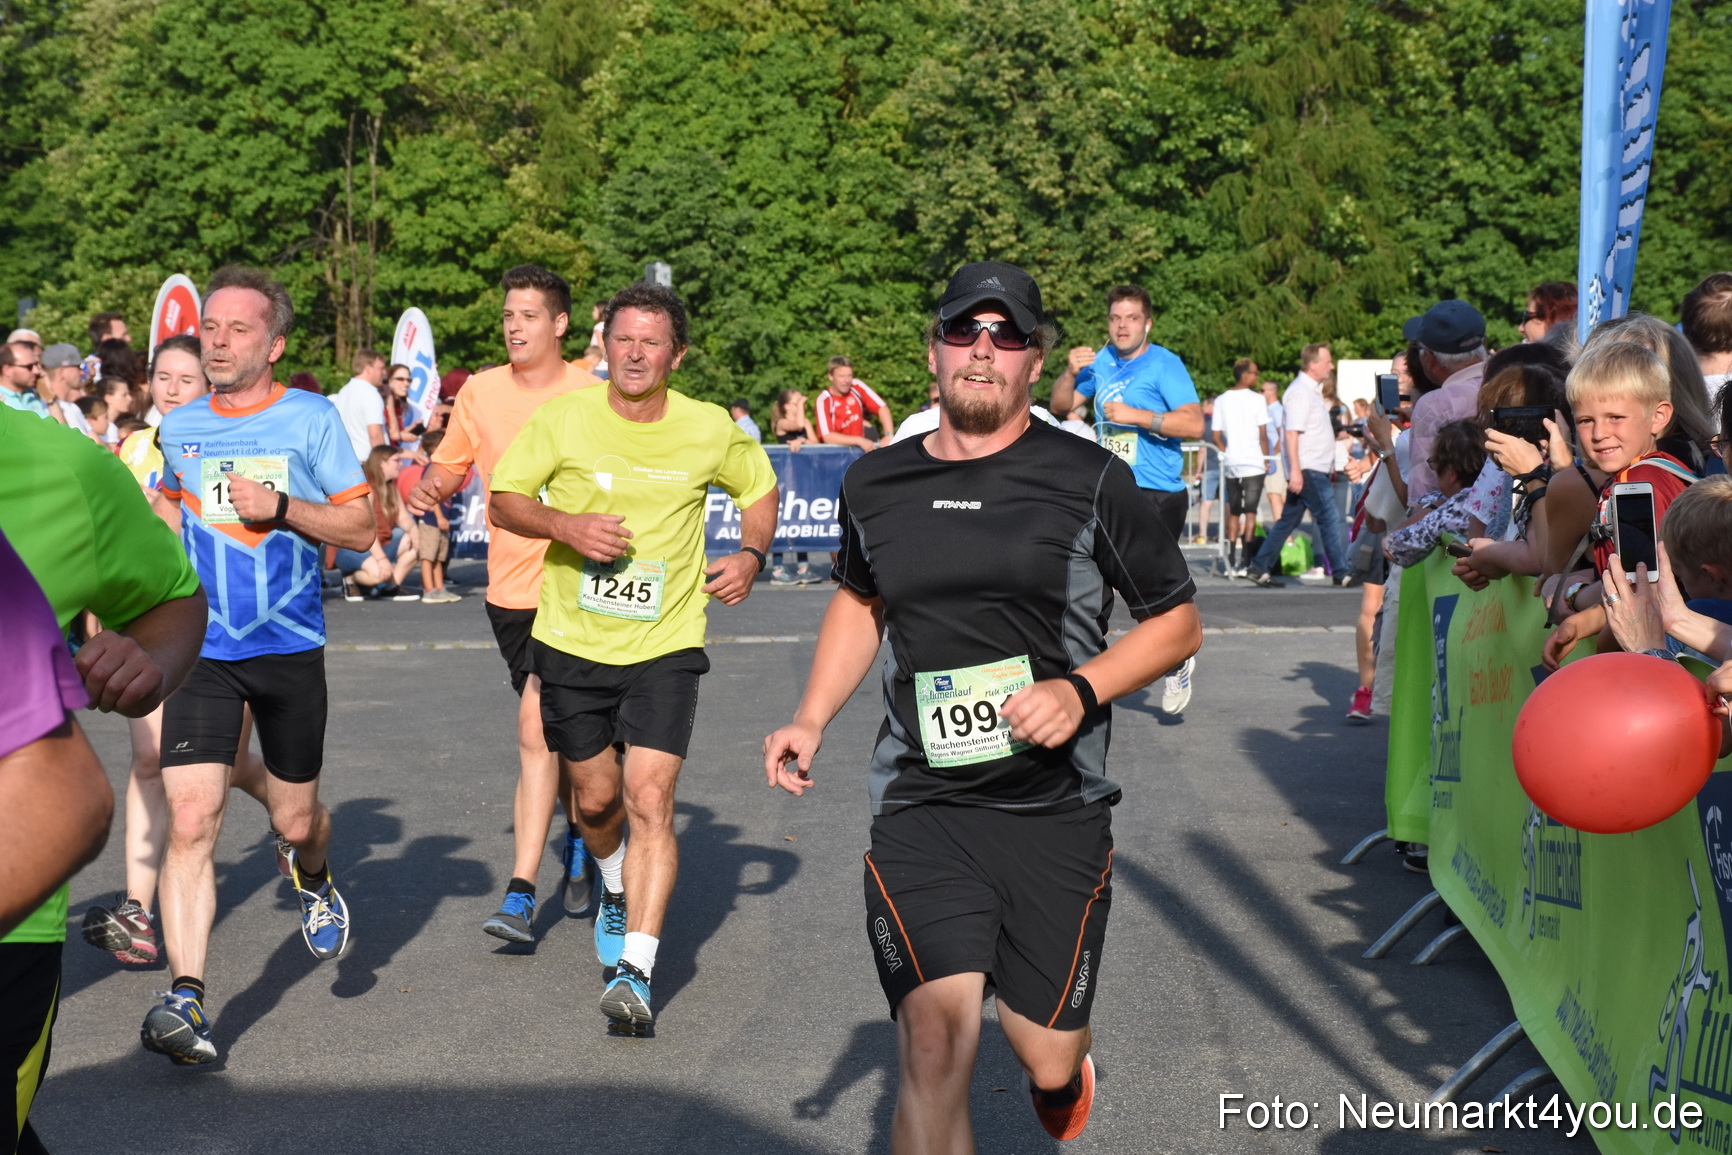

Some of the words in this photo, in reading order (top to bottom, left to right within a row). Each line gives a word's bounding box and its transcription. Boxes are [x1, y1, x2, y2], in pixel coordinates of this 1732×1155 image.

[976, 283, 1006, 292] adidas
[203, 448, 240, 457] Neumarkt
[204, 439, 259, 449] Raiffeisenbank
[1103, 438, 1130, 455] 1534
[704, 491, 840, 522] Fihe
[933, 500, 982, 510] STANNO
[715, 524, 840, 540] AUMOBILE
[591, 574, 652, 603] 1245
[582, 593, 633, 609] Kerschensteiner
[634, 603, 656, 611] Hubert
[929, 686, 972, 700] firmenlauf
[1003, 680, 1026, 694] 2019
[931, 694, 1013, 740] 199
[930, 734, 1000, 751] Rauchensteiner
[950, 748, 973, 757] Wagner
[974, 743, 1000, 753] Stiftung
[1713, 842, 1732, 880] Fisc
[874, 916, 903, 973] OMM
[1071, 950, 1091, 1008] OMM
